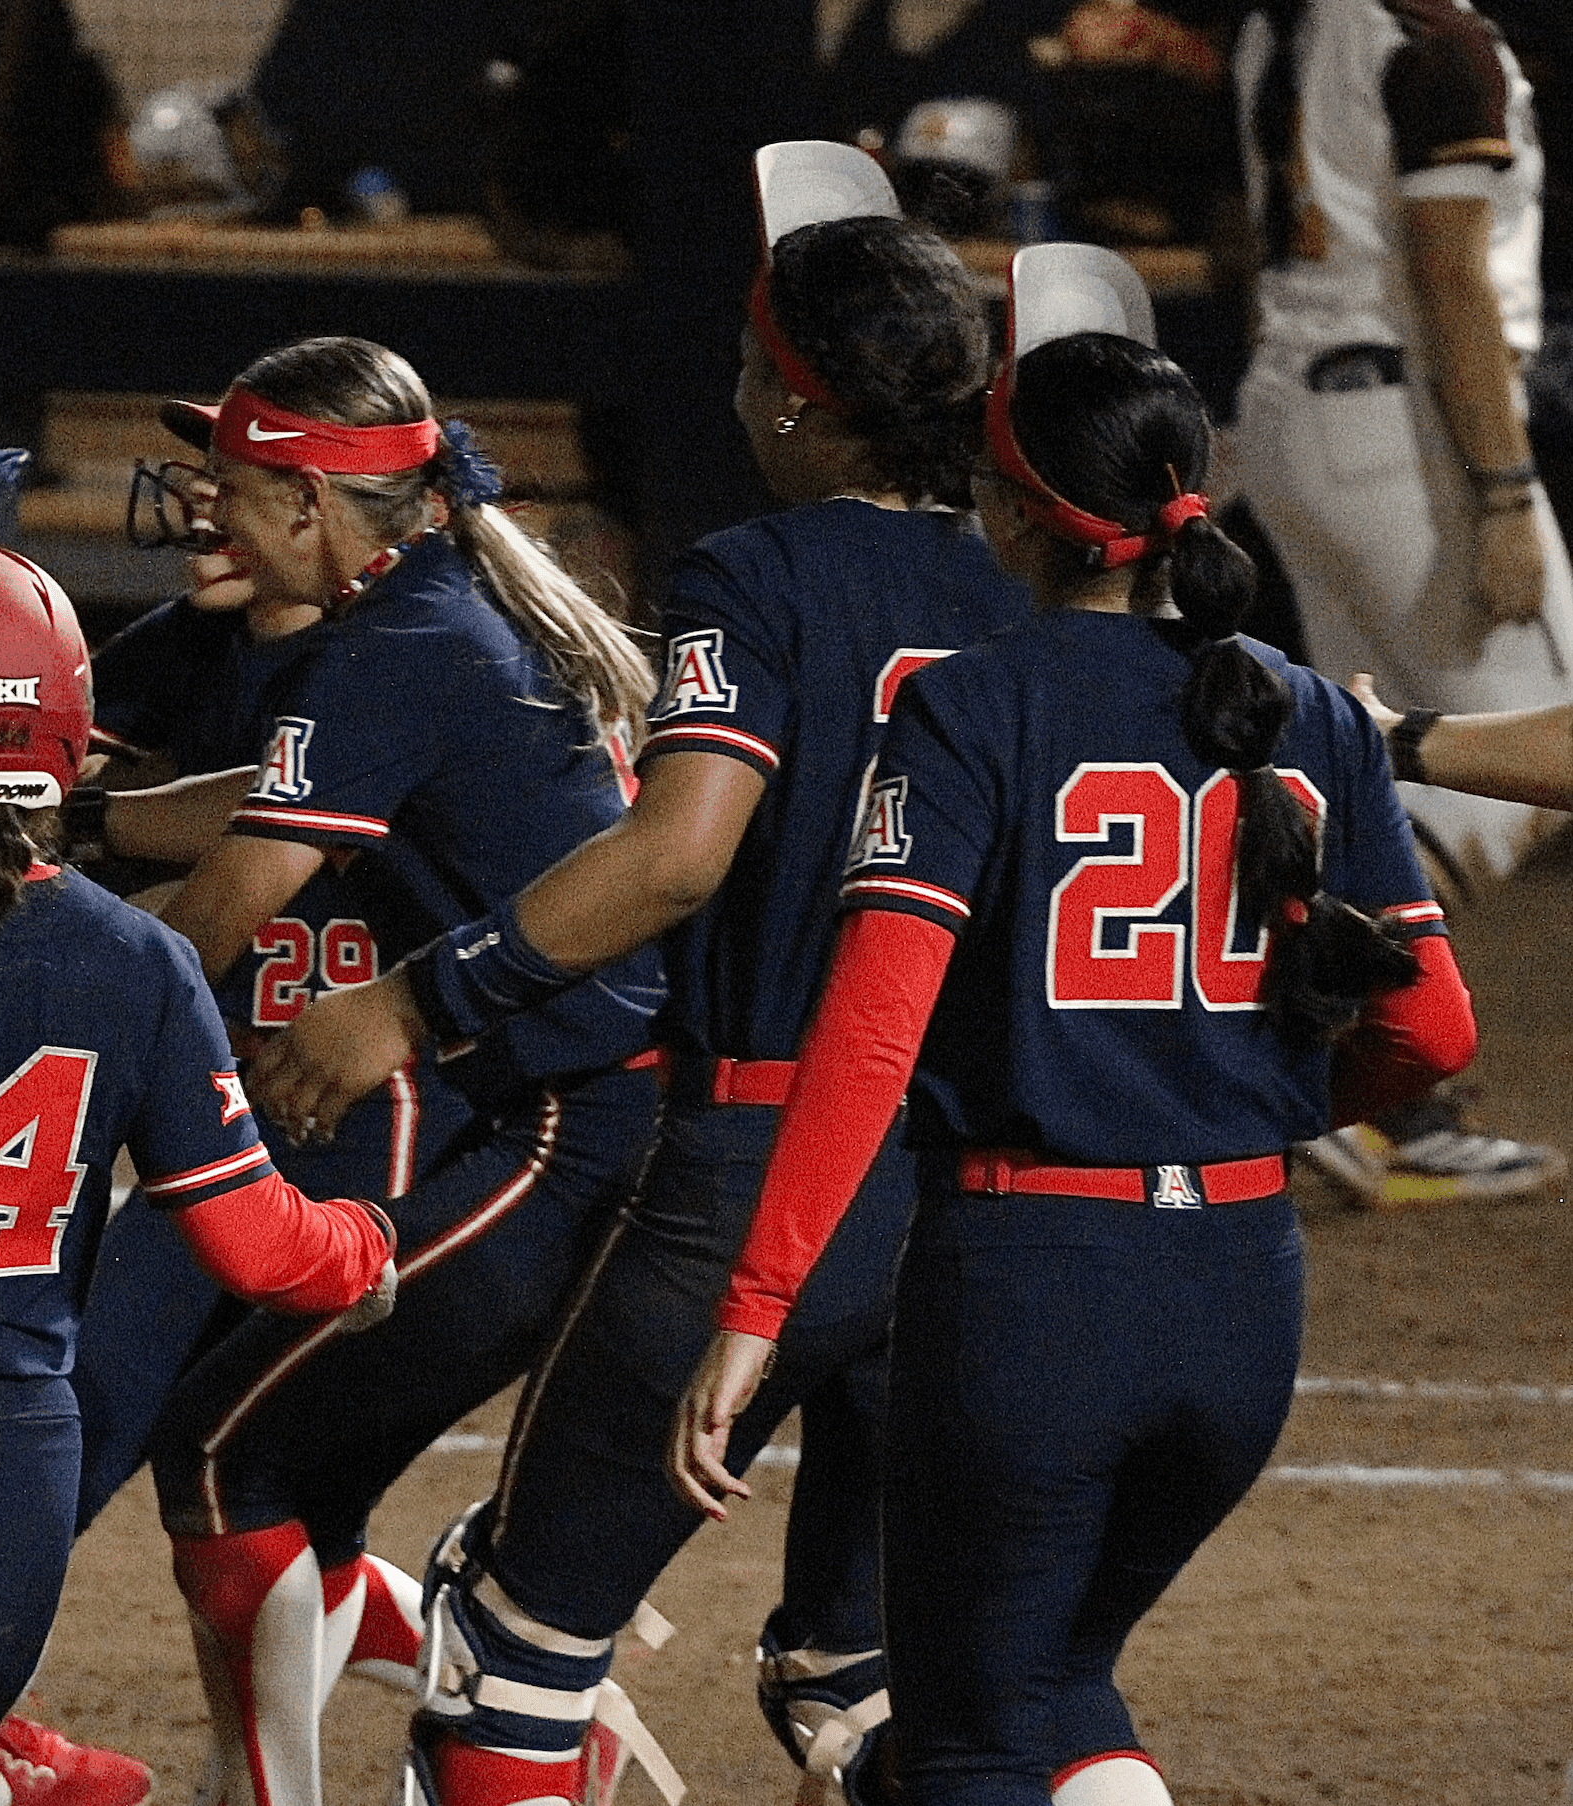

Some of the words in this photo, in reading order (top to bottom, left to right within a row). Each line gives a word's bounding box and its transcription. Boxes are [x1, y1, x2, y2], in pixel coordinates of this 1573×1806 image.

[647, 629, 738, 722] A
[247, 716, 315, 802] A
[842, 775, 913, 875] A
[1045, 762, 1327, 1012] 20
[1152, 1164, 1202, 1210] A
